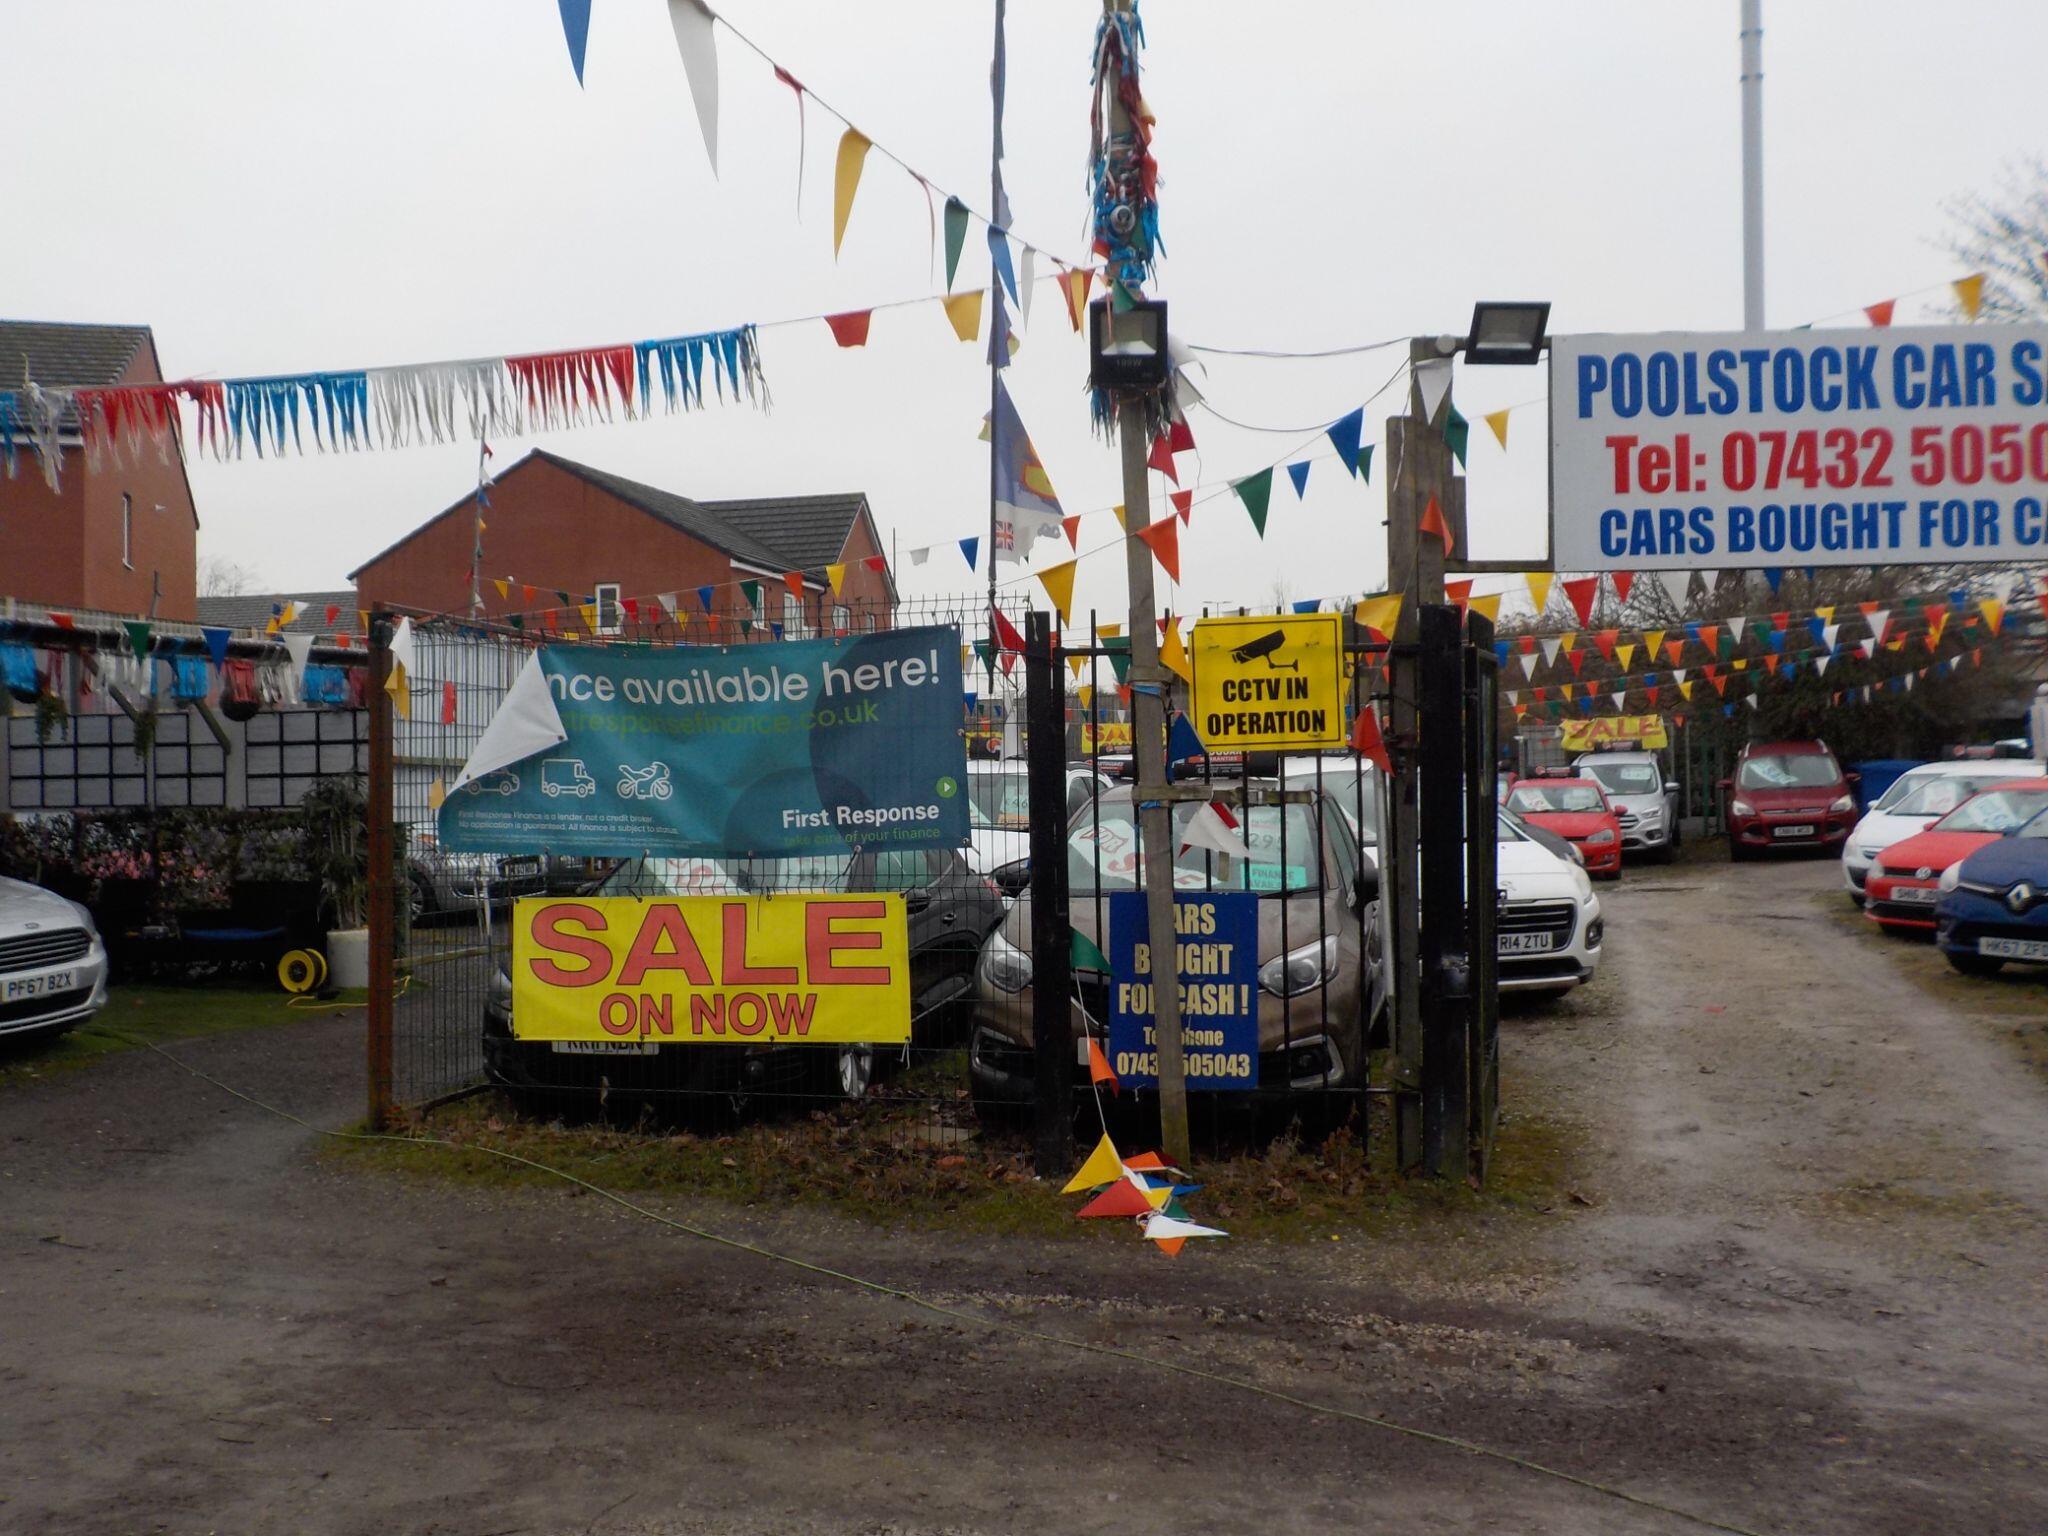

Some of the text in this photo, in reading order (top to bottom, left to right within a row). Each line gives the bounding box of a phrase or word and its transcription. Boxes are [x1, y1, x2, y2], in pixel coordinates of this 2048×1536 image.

[1577, 339, 2048, 419] POOLSTOCK CAR S
[1605, 433, 1706, 494] Tel:
[1722, 426, 1893, 492] 07432
[1599, 496, 2048, 557] CARS BOUGHT FOR C
[622, 666, 809, 705] available
[822, 649, 940, 697] here!
[1222, 677, 1309, 703] CCTV IN
[1207, 709, 1326, 737] OPERATION
[514, 811, 542, 820] Finance
[606, 814, 629, 822] credit
[580, 823, 608, 831] finance
[618, 824, 645, 834] subject
[783, 804, 941, 829] First Response
[861, 831, 888, 844] your
[892, 826, 941, 840] finance
[1173, 903, 1217, 935] ARS
[529, 901, 891, 988] SALE
[1524, 934, 1549, 949] ZTU
[48, 971, 72, 990] BZX
[599, 992, 817, 1036] ON NOW
